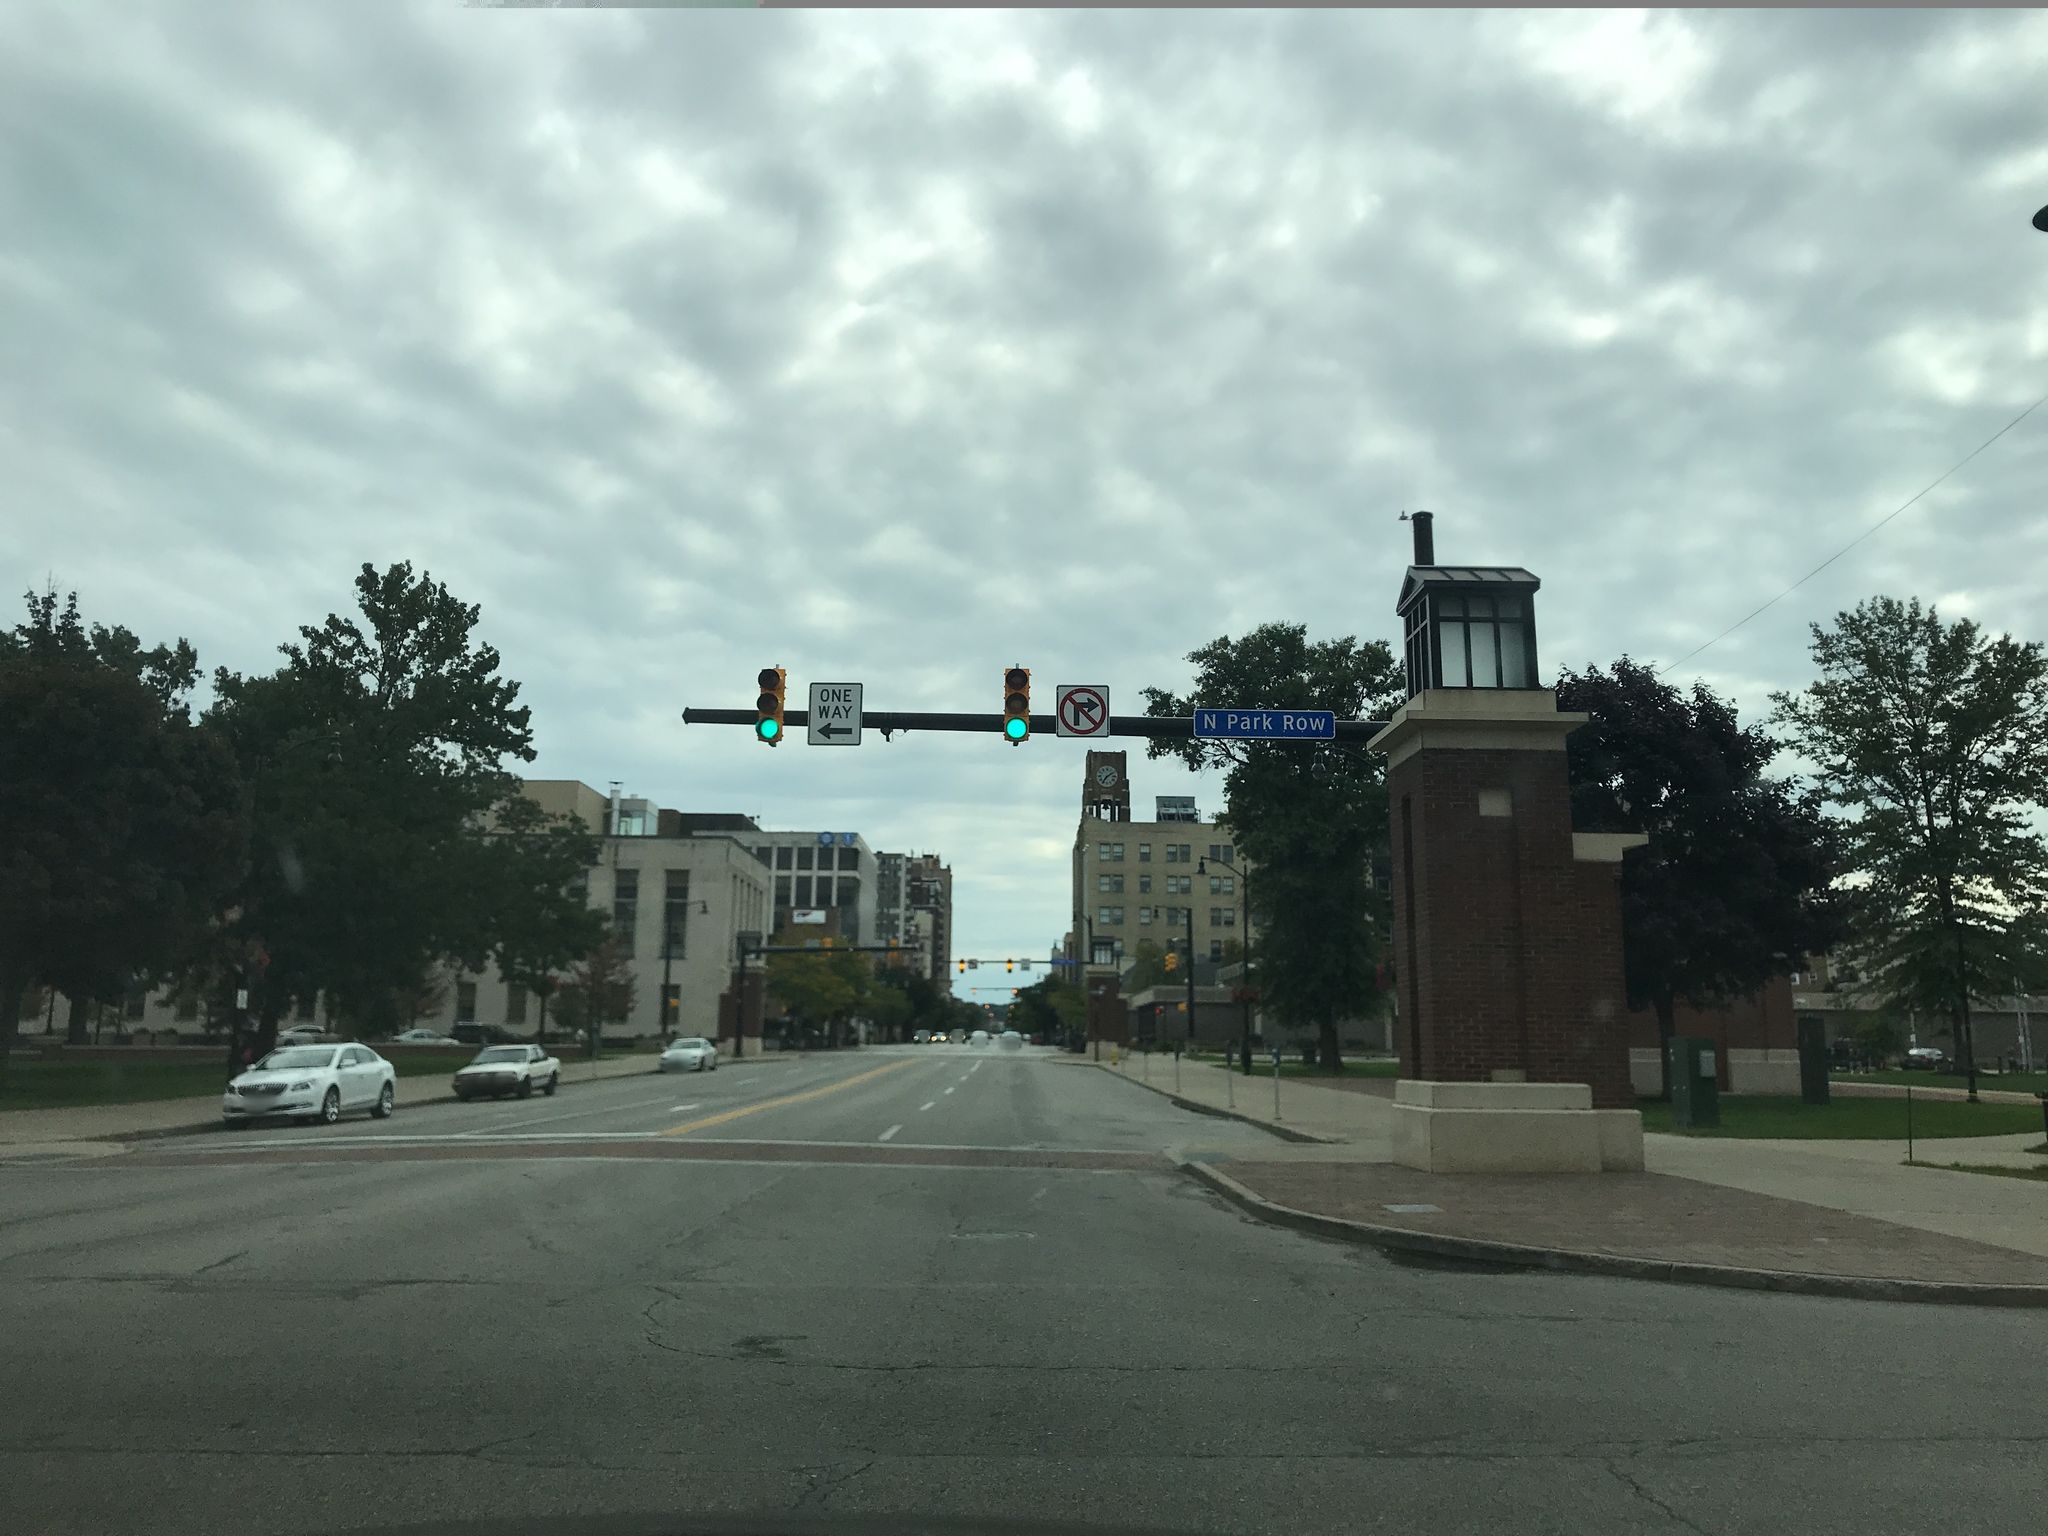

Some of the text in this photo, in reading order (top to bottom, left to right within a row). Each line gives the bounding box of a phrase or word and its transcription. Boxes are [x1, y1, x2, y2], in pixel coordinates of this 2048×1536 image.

[820, 689, 852, 702] ONE
[818, 705, 852, 719] WAY
[1204, 713, 1326, 731] N Park Row
